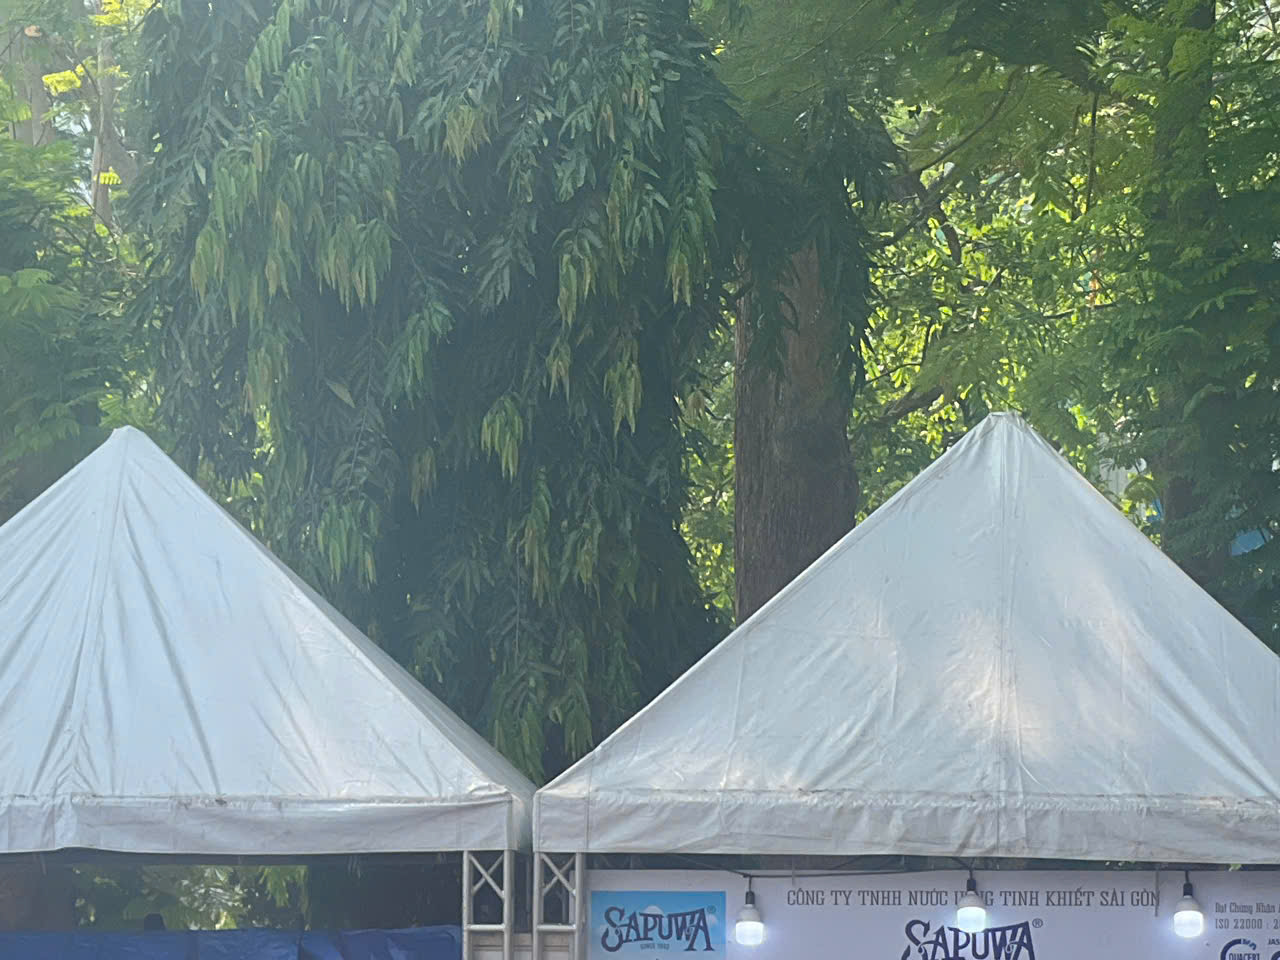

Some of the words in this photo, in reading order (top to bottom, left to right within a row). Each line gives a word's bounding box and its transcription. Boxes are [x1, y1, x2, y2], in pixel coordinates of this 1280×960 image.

[787, 888, 825, 906] CÔNG
[830, 890, 853, 906] TY
[858, 890, 902, 906] TNHH
[908, 888, 949, 906] NƯỚC
[1000, 890, 1040, 906] TINH
[1045, 887, 1095, 906] KHIẾT
[1100, 888, 1125, 906] SÀI
[1130, 888, 1160, 906] GÒN
[601, 906, 715, 952] SAPUWA
[1215, 918, 1230, 930] ISO
[1233, 918, 1263, 930] 22000
